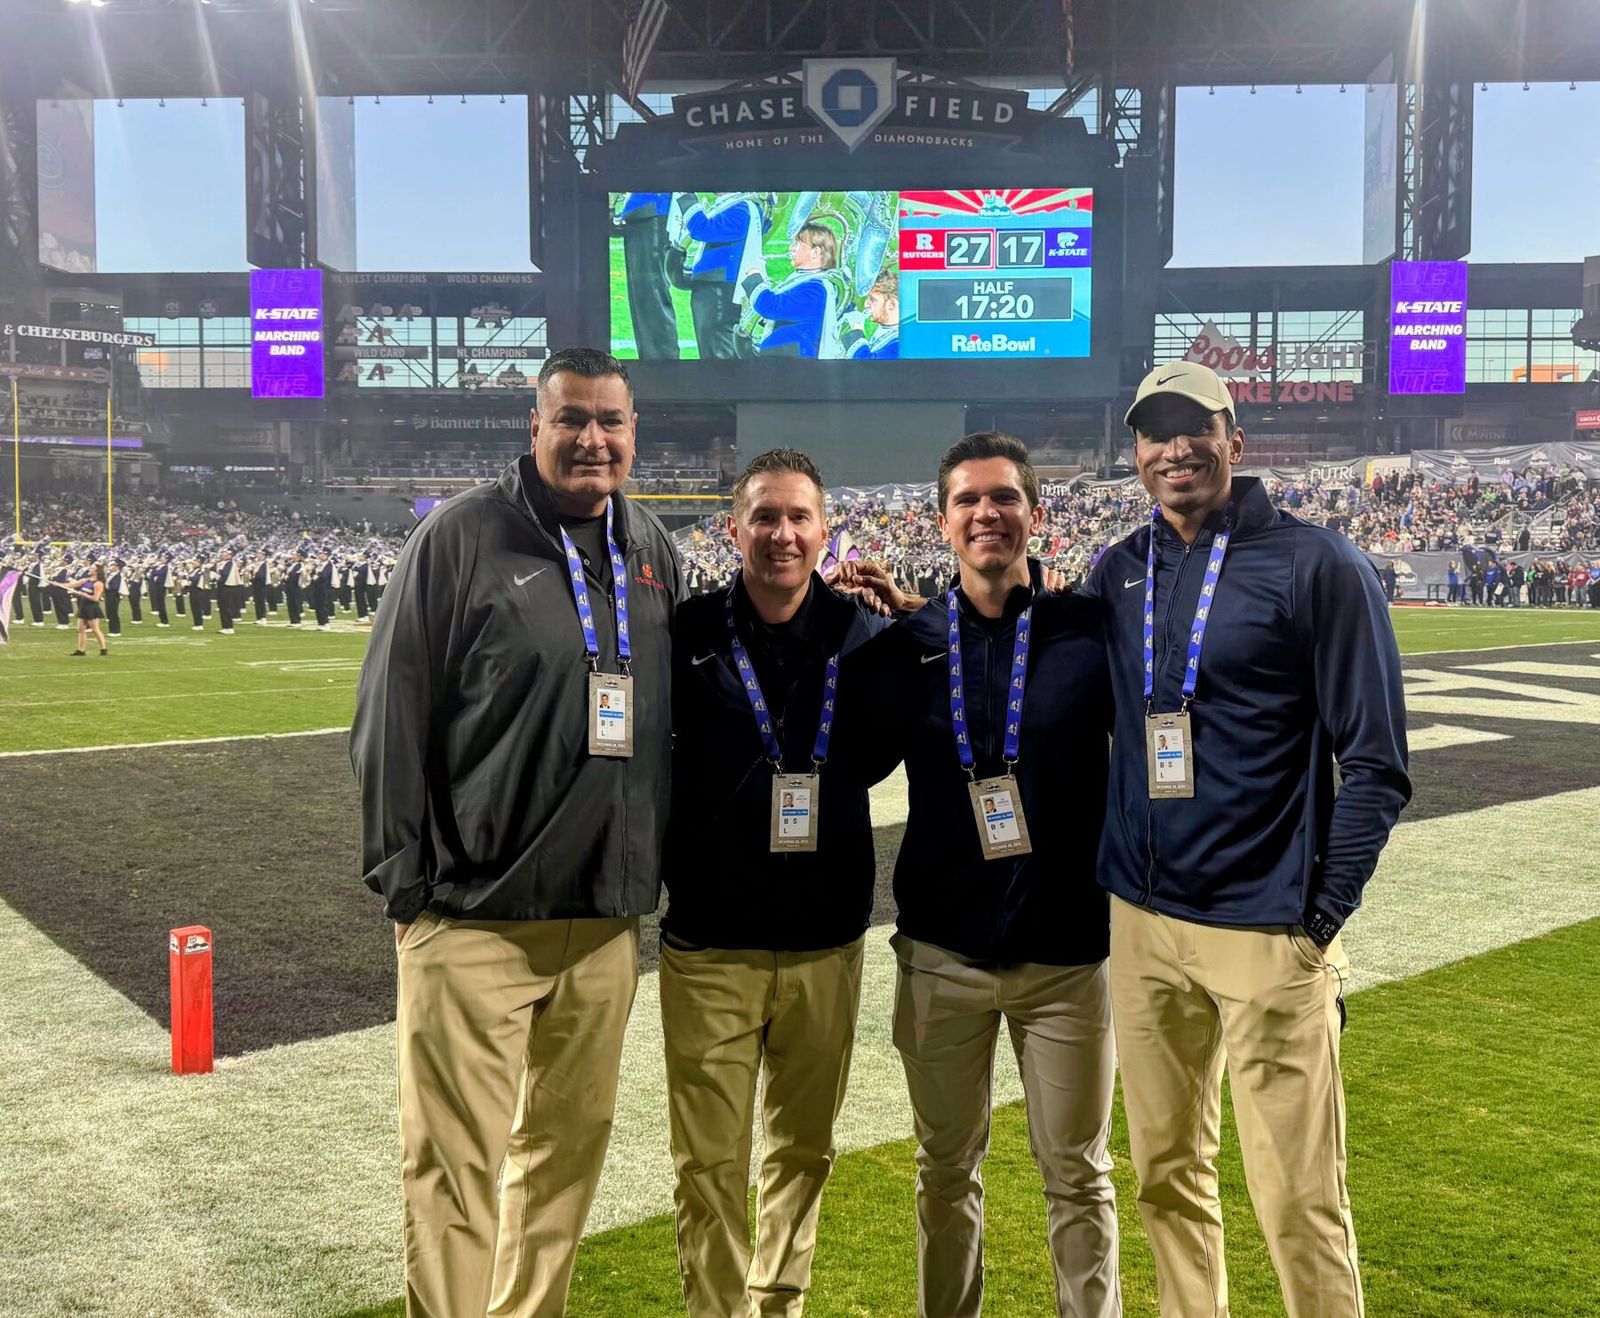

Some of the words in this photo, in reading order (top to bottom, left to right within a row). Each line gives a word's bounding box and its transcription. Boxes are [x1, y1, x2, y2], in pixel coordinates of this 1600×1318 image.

[686, 97, 795, 128] CHASE
[904, 96, 1015, 124] FIELD
[726, 137, 763, 150] HOME
[773, 136, 790, 146] OF
[800, 134, 825, 144] THE
[874, 134, 974, 148] DIAMONDBACKS
[915, 233, 935, 251] R
[902, 251, 945, 259] RUTGERS
[949, 236, 990, 264] 27
[1002, 236, 1042, 263] 17
[1048, 248, 1088, 257] K-STATE
[374, 274, 428, 284] CHAMPIONS
[447, 274, 478, 284] WORLD
[480, 274, 533, 285] CHAMPIONS
[973, 281, 1014, 295] HALF
[955, 295, 1034, 319] 17:20
[1395, 301, 1463, 314] K-STATE
[254, 308, 319, 320] K-STATE
[4, 324, 14, 336] &
[17, 325, 154, 347] CHEESEBURGERS
[254, 330, 320, 342] MARCHING
[1394, 324, 1463, 336] MARCHING
[269, 345, 306, 356] BAND
[1409, 339, 1448, 351] BAND
[353, 349, 377, 358] WILD
[380, 349, 405, 358] CARD
[456, 349, 470, 358] NL
[471, 349, 529, 359] CHAMPIONS
[1183, 335, 1275, 371] Coors
[1279, 344, 1366, 370] LIGHT
[1278, 381, 1354, 402] ZONE
[430, 416, 481, 429] Banner
[484, 416, 530, 429] Health
